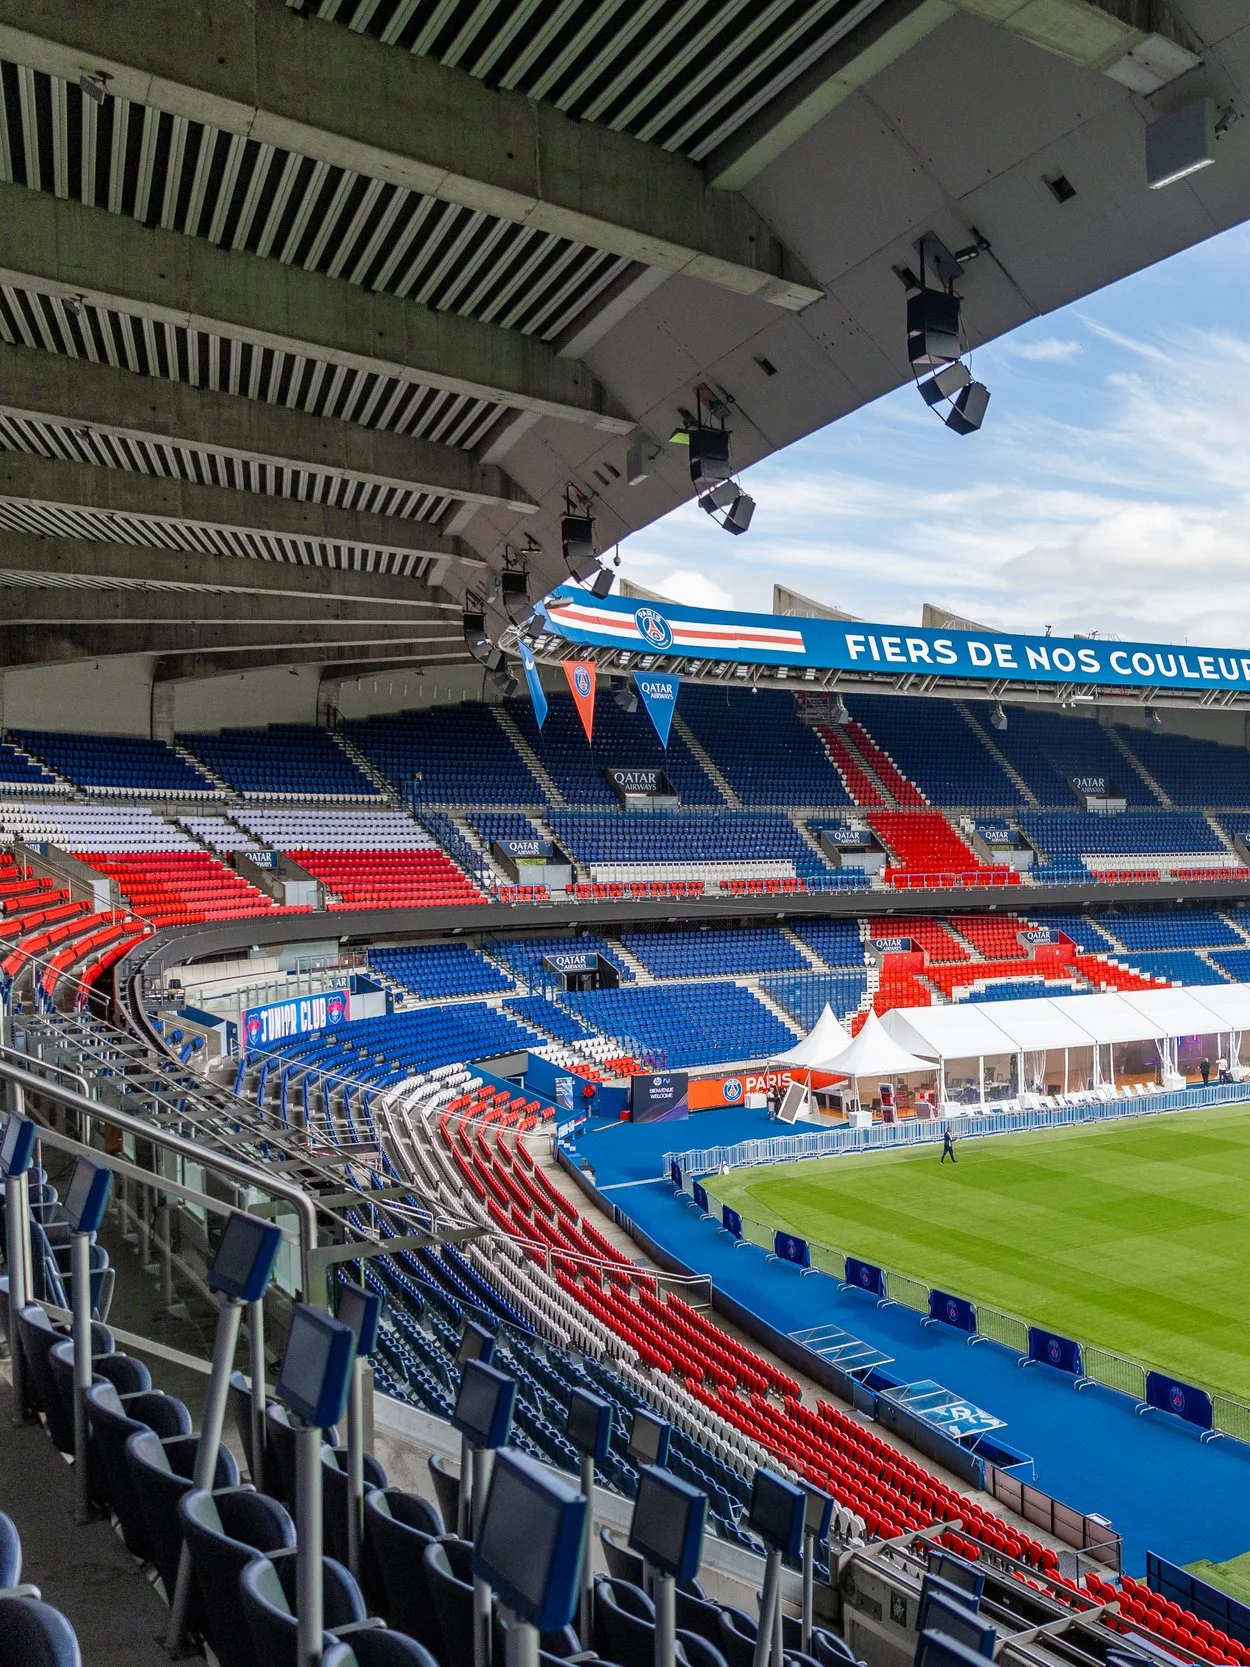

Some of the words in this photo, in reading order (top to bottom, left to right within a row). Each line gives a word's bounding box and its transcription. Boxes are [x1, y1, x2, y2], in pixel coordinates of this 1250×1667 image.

[638, 610, 661, 622] PARIS
[845, 633, 957, 664] FIERS
[967, 641, 1017, 669] DE
[1025, 645, 1100, 673] NOS
[641, 682, 673, 694] QATAR
[650, 691, 673, 700] AIRWAYS
[614, 772, 656, 785] QATAR
[1073, 778, 1104, 788] QATAR
[625, 783, 656, 791] AIRWAYS
[834, 832, 859, 842] QATAR
[985, 832, 1008, 842] QATAR
[509, 842, 539, 851] QATAR
[1027, 931, 1050, 941] QATAR
[876, 939, 902, 949] QATAR
[556, 955, 587, 967] QATAR
[261, 1003, 297, 1043] JUNIOR
[300, 998, 326, 1033] CLUB
[746, 1072, 792, 1092] PARIS
